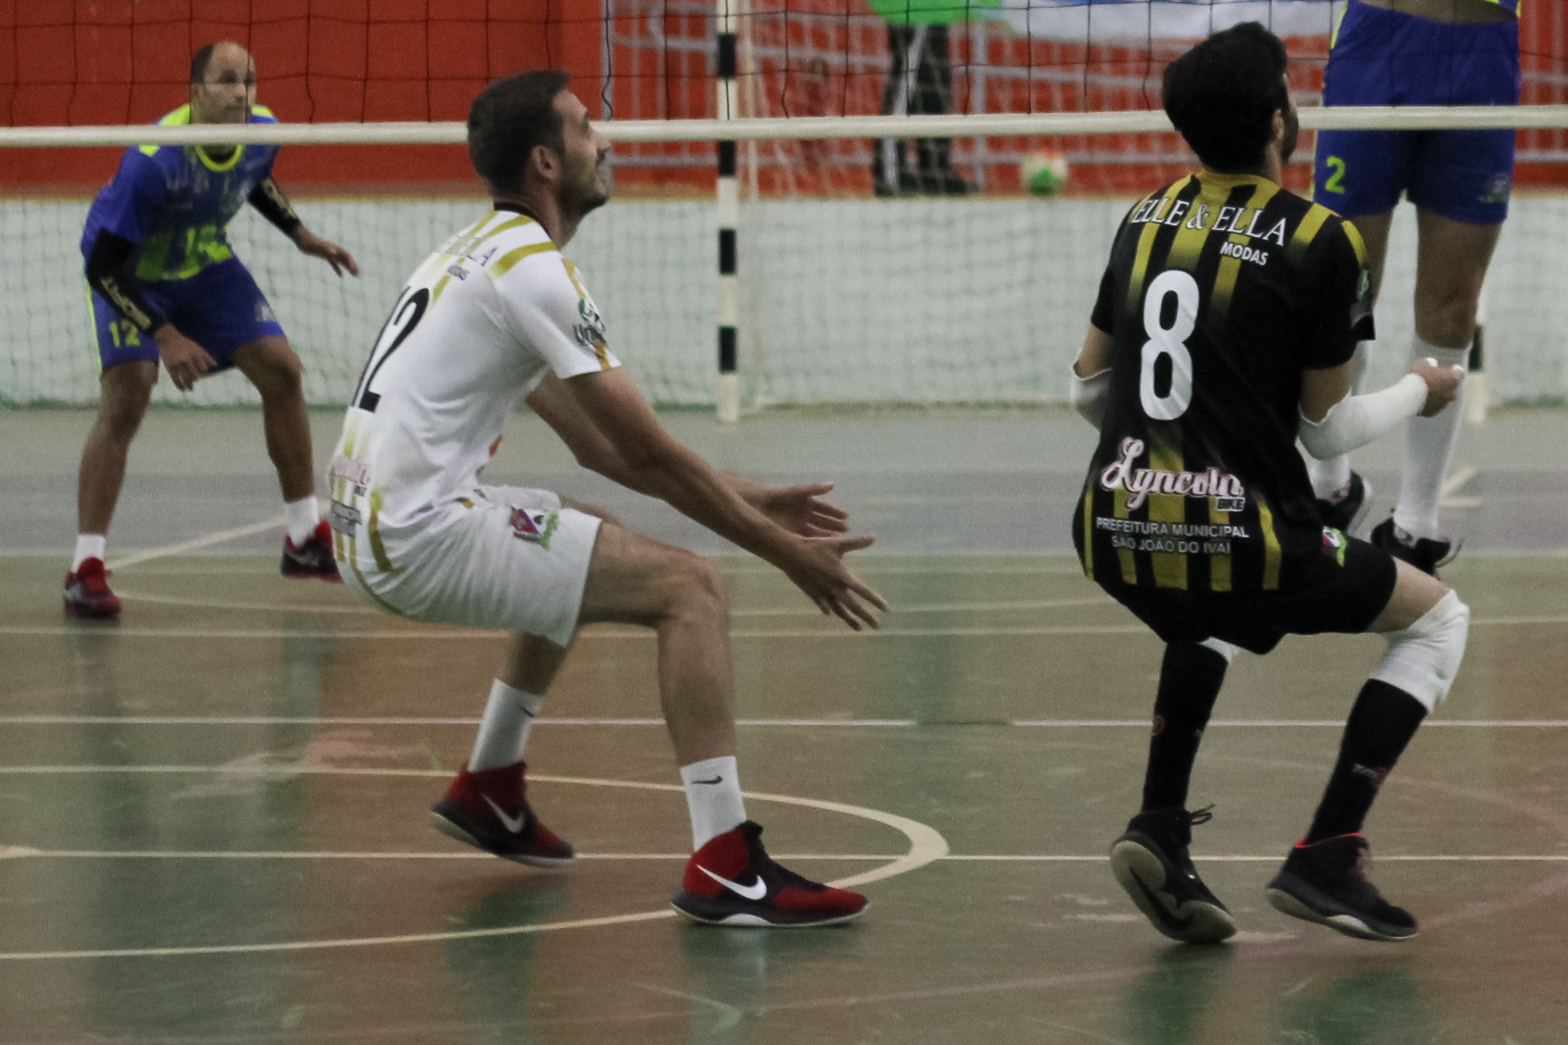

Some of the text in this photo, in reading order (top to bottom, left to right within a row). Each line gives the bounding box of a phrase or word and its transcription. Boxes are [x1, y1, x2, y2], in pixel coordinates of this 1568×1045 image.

[1324, 156, 1346, 194] 2
[1132, 198, 1288, 246] ELLE & ELLA
[1219, 241, 1269, 266] MODAS
[109, 320, 141, 347] 12
[1140, 269, 1200, 420] 8
[1101, 436, 1245, 511] Lyncoln
[1096, 516, 1250, 539] PREFEITURA MUNICIPAL
[1178, 541, 1200, 553] DO
